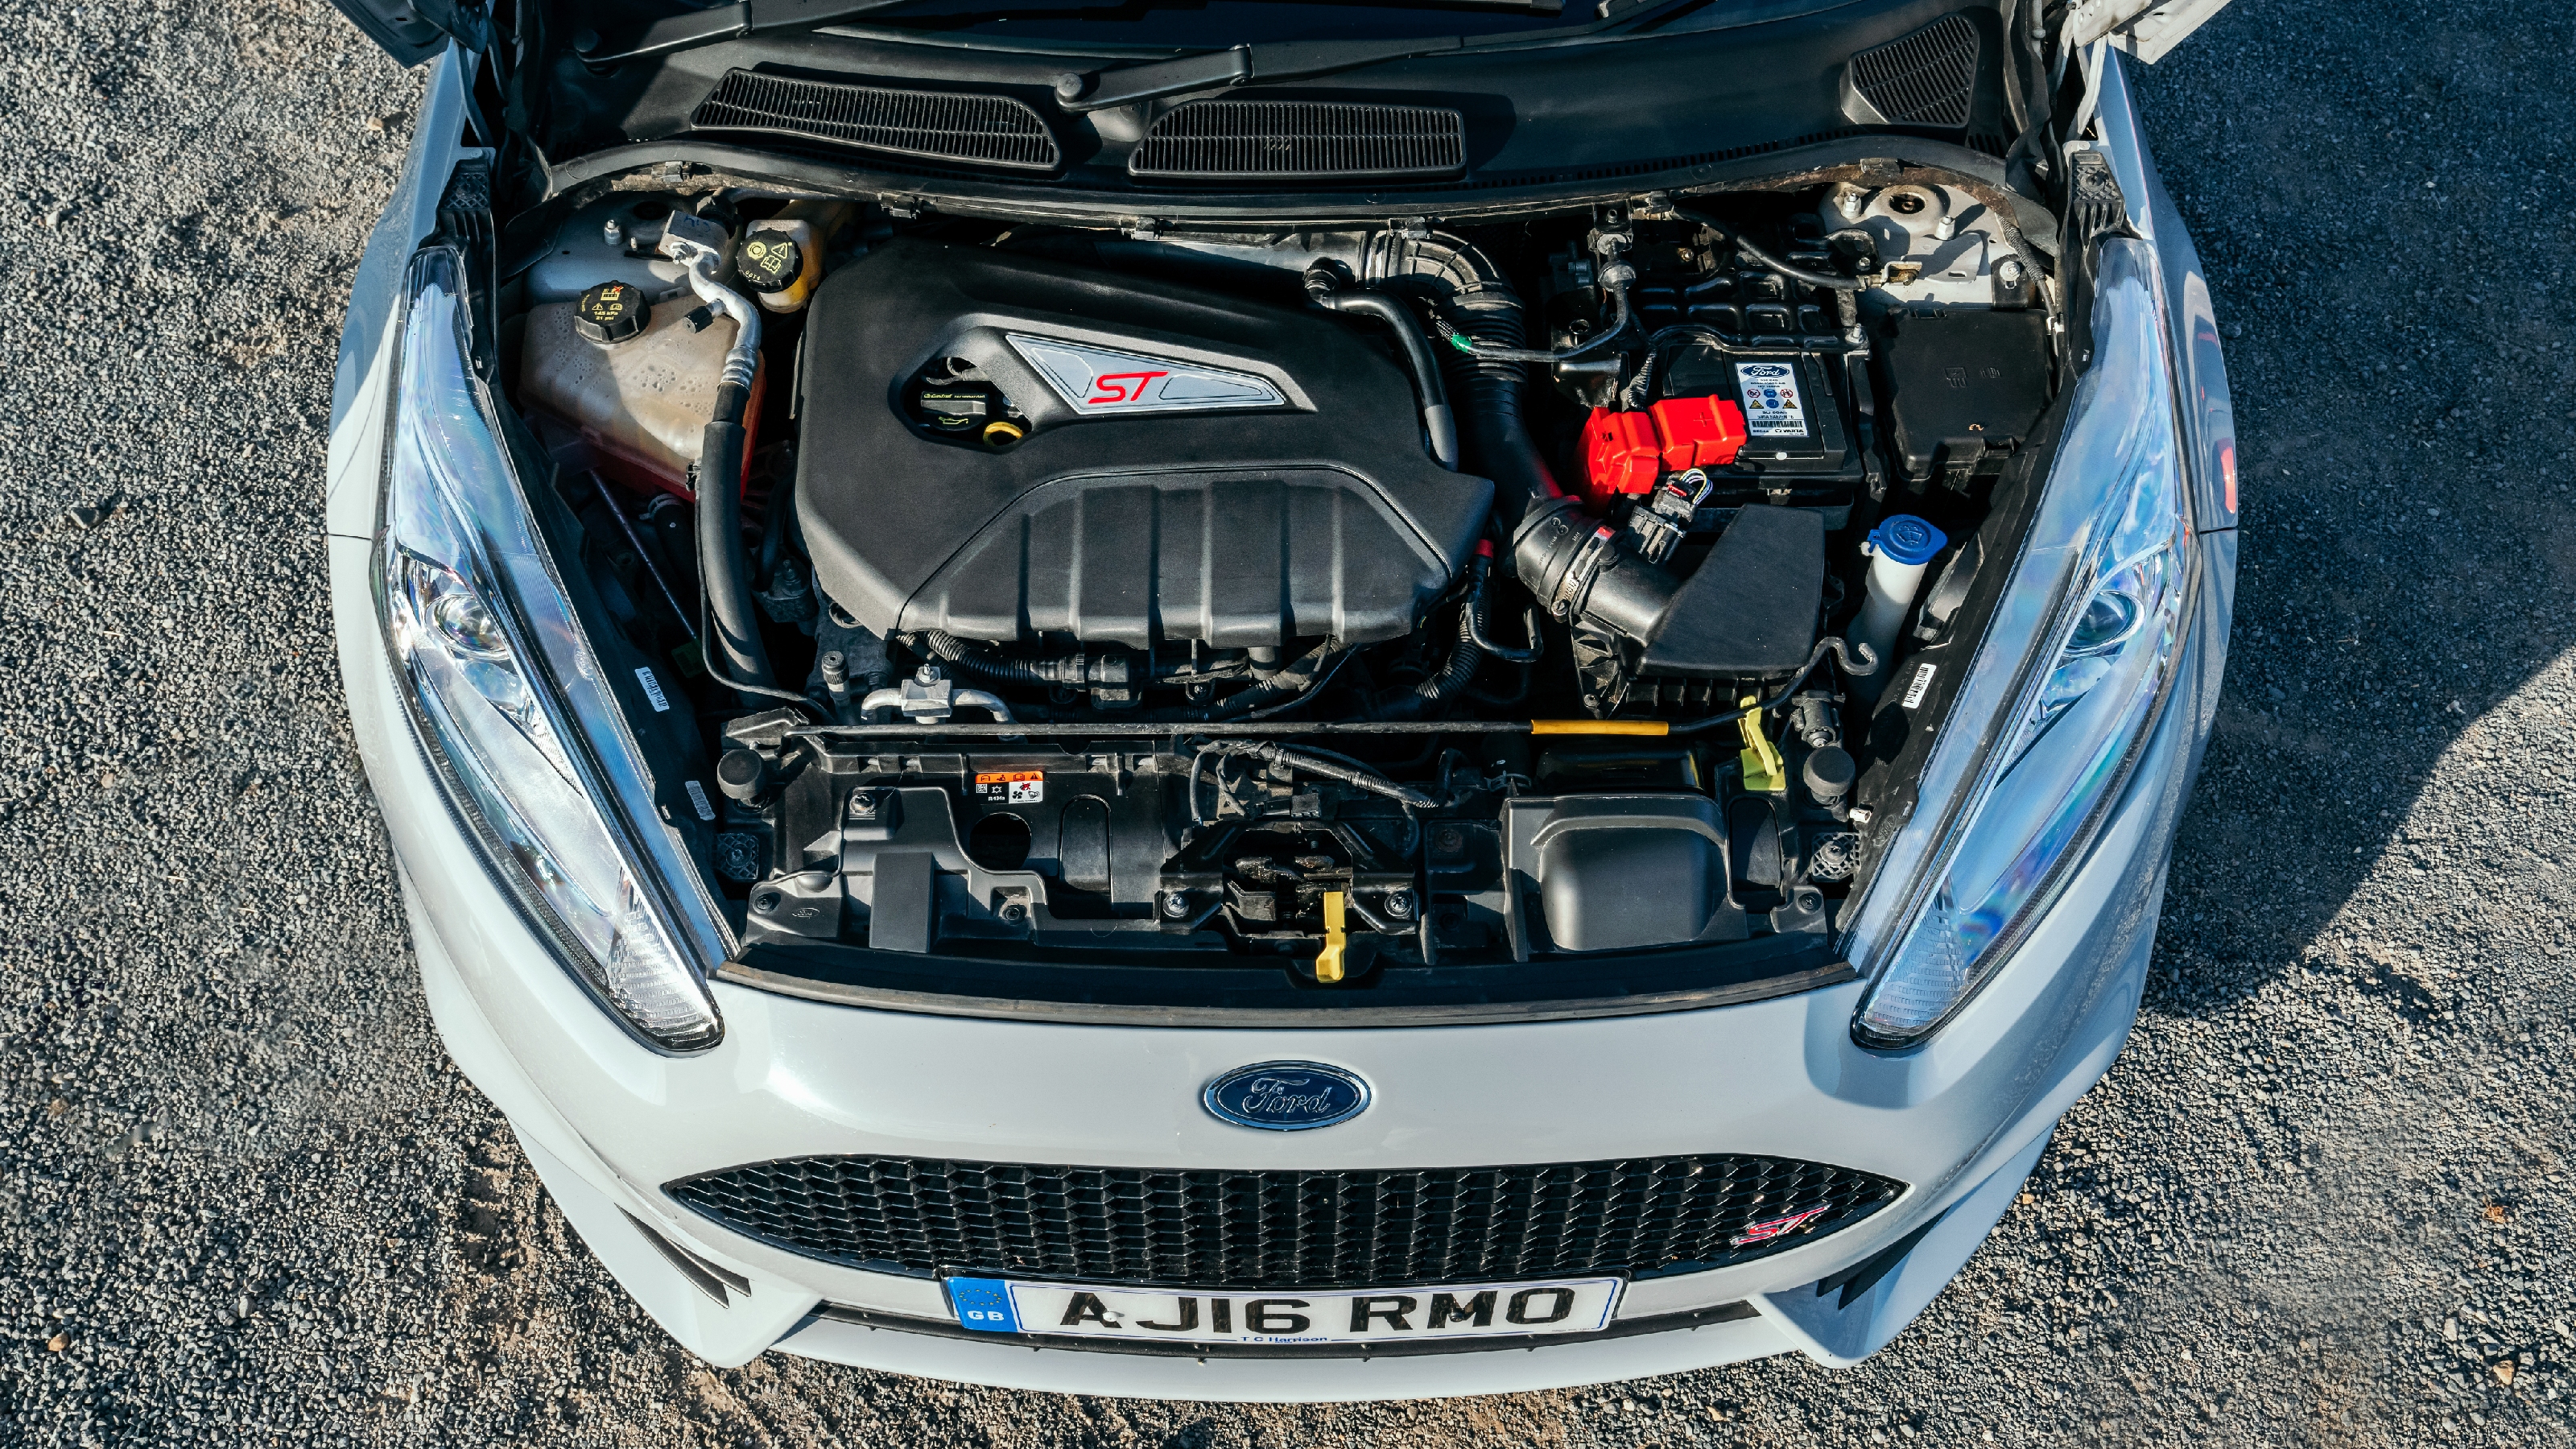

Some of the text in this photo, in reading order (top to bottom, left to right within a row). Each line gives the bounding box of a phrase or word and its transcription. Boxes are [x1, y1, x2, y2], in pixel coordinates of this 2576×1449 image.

[1088, 370, 1170, 404] ST
[1750, 366, 1780, 376] Ford
[1242, 1076, 1333, 1114] Ford
[1729, 1202, 1833, 1246] ST
[967, 1310, 1005, 1321] GB
[1059, 1287, 1575, 1334] AJ16 RMO
